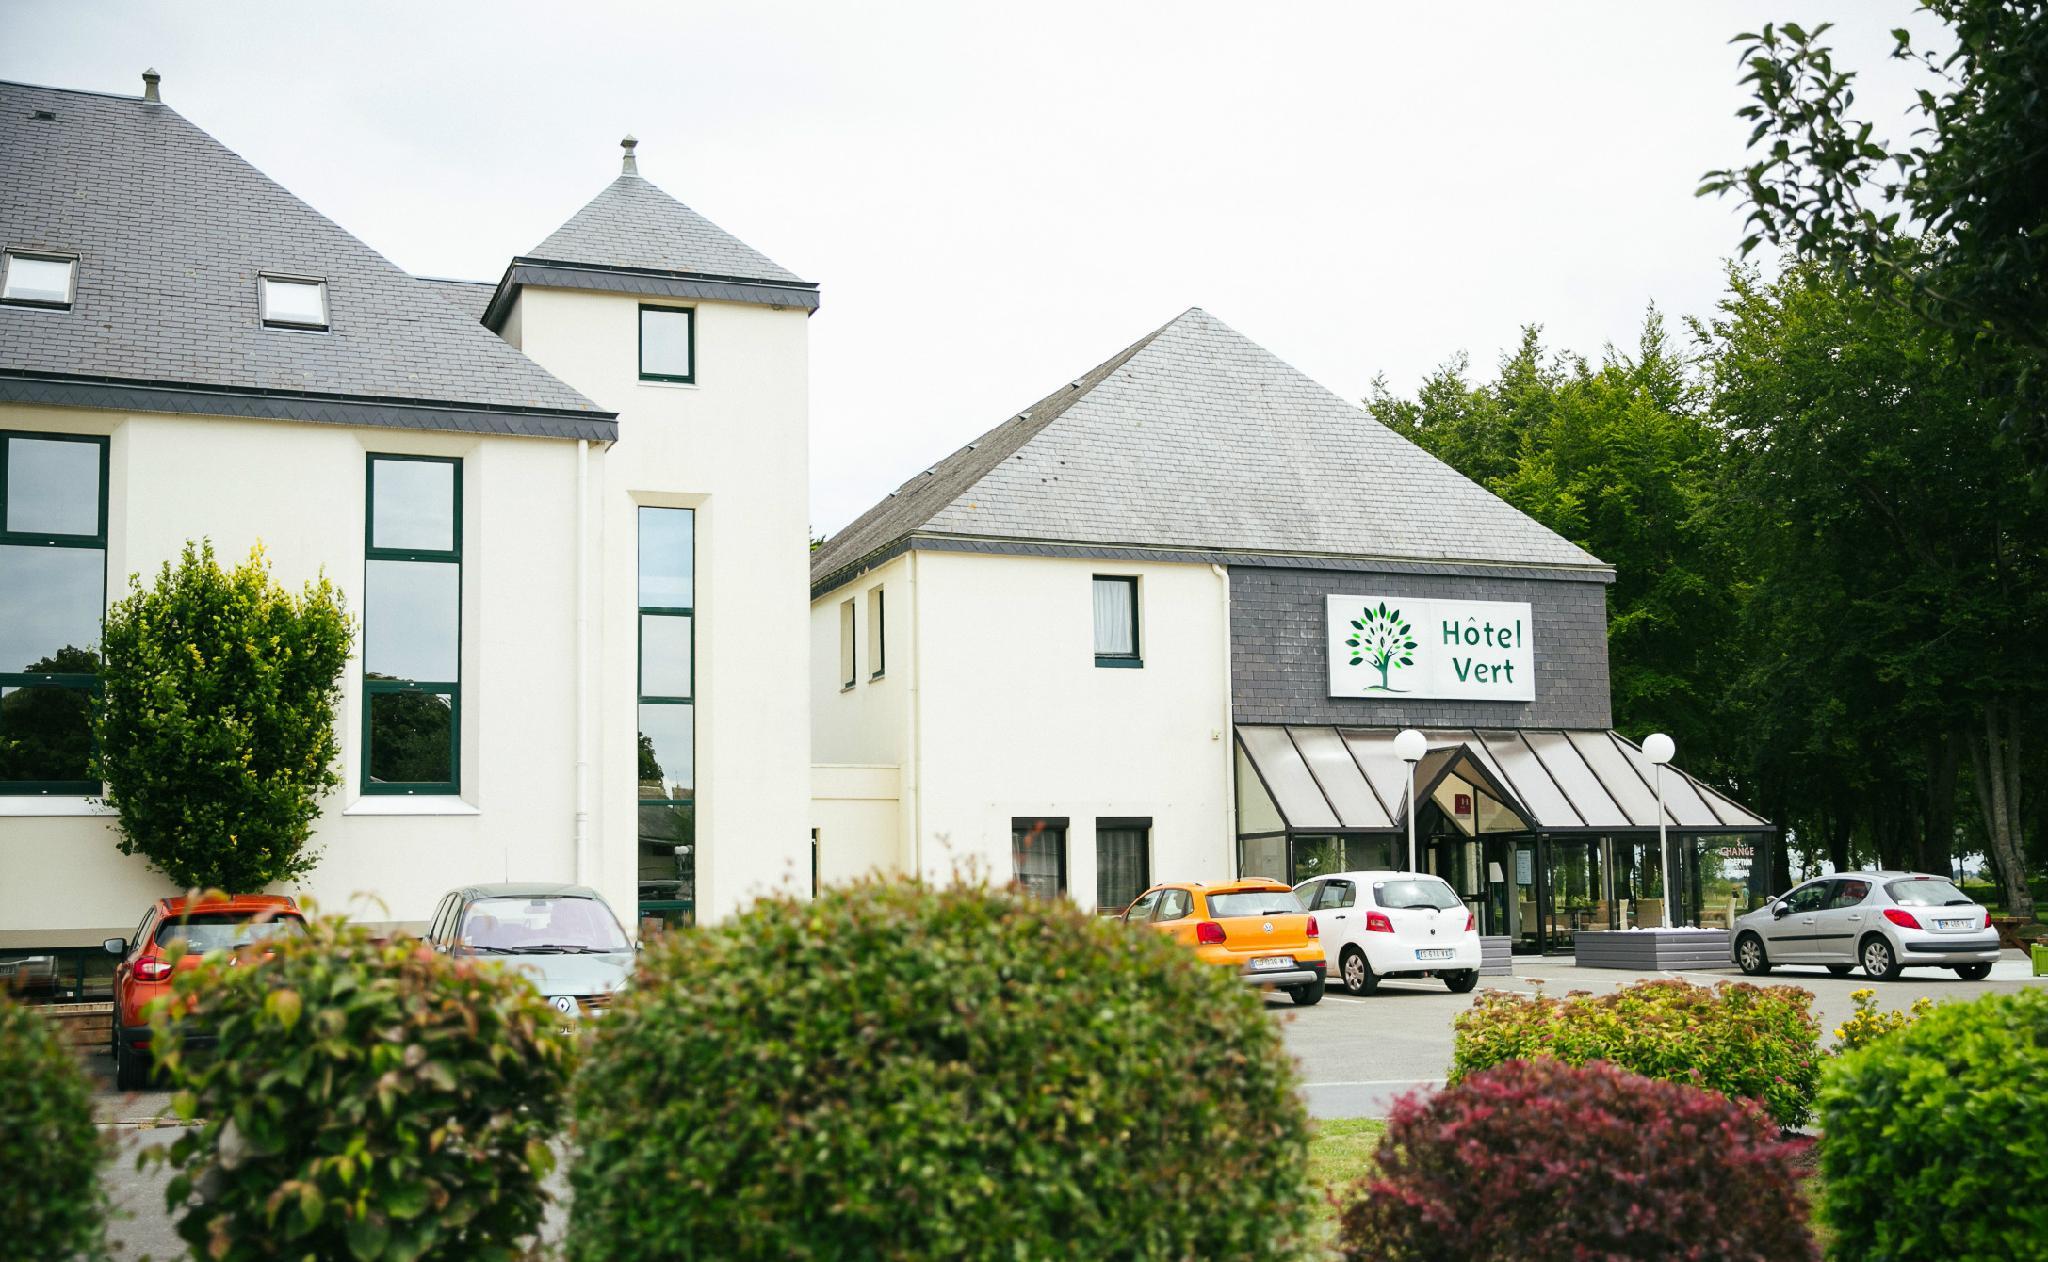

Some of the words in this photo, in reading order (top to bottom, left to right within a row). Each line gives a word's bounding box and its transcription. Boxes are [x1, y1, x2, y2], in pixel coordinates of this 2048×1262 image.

[1442, 616, 1521, 649] Hôtel
[1452, 657, 1514, 684] Vert
[1720, 847, 1754, 857] CHANGE
